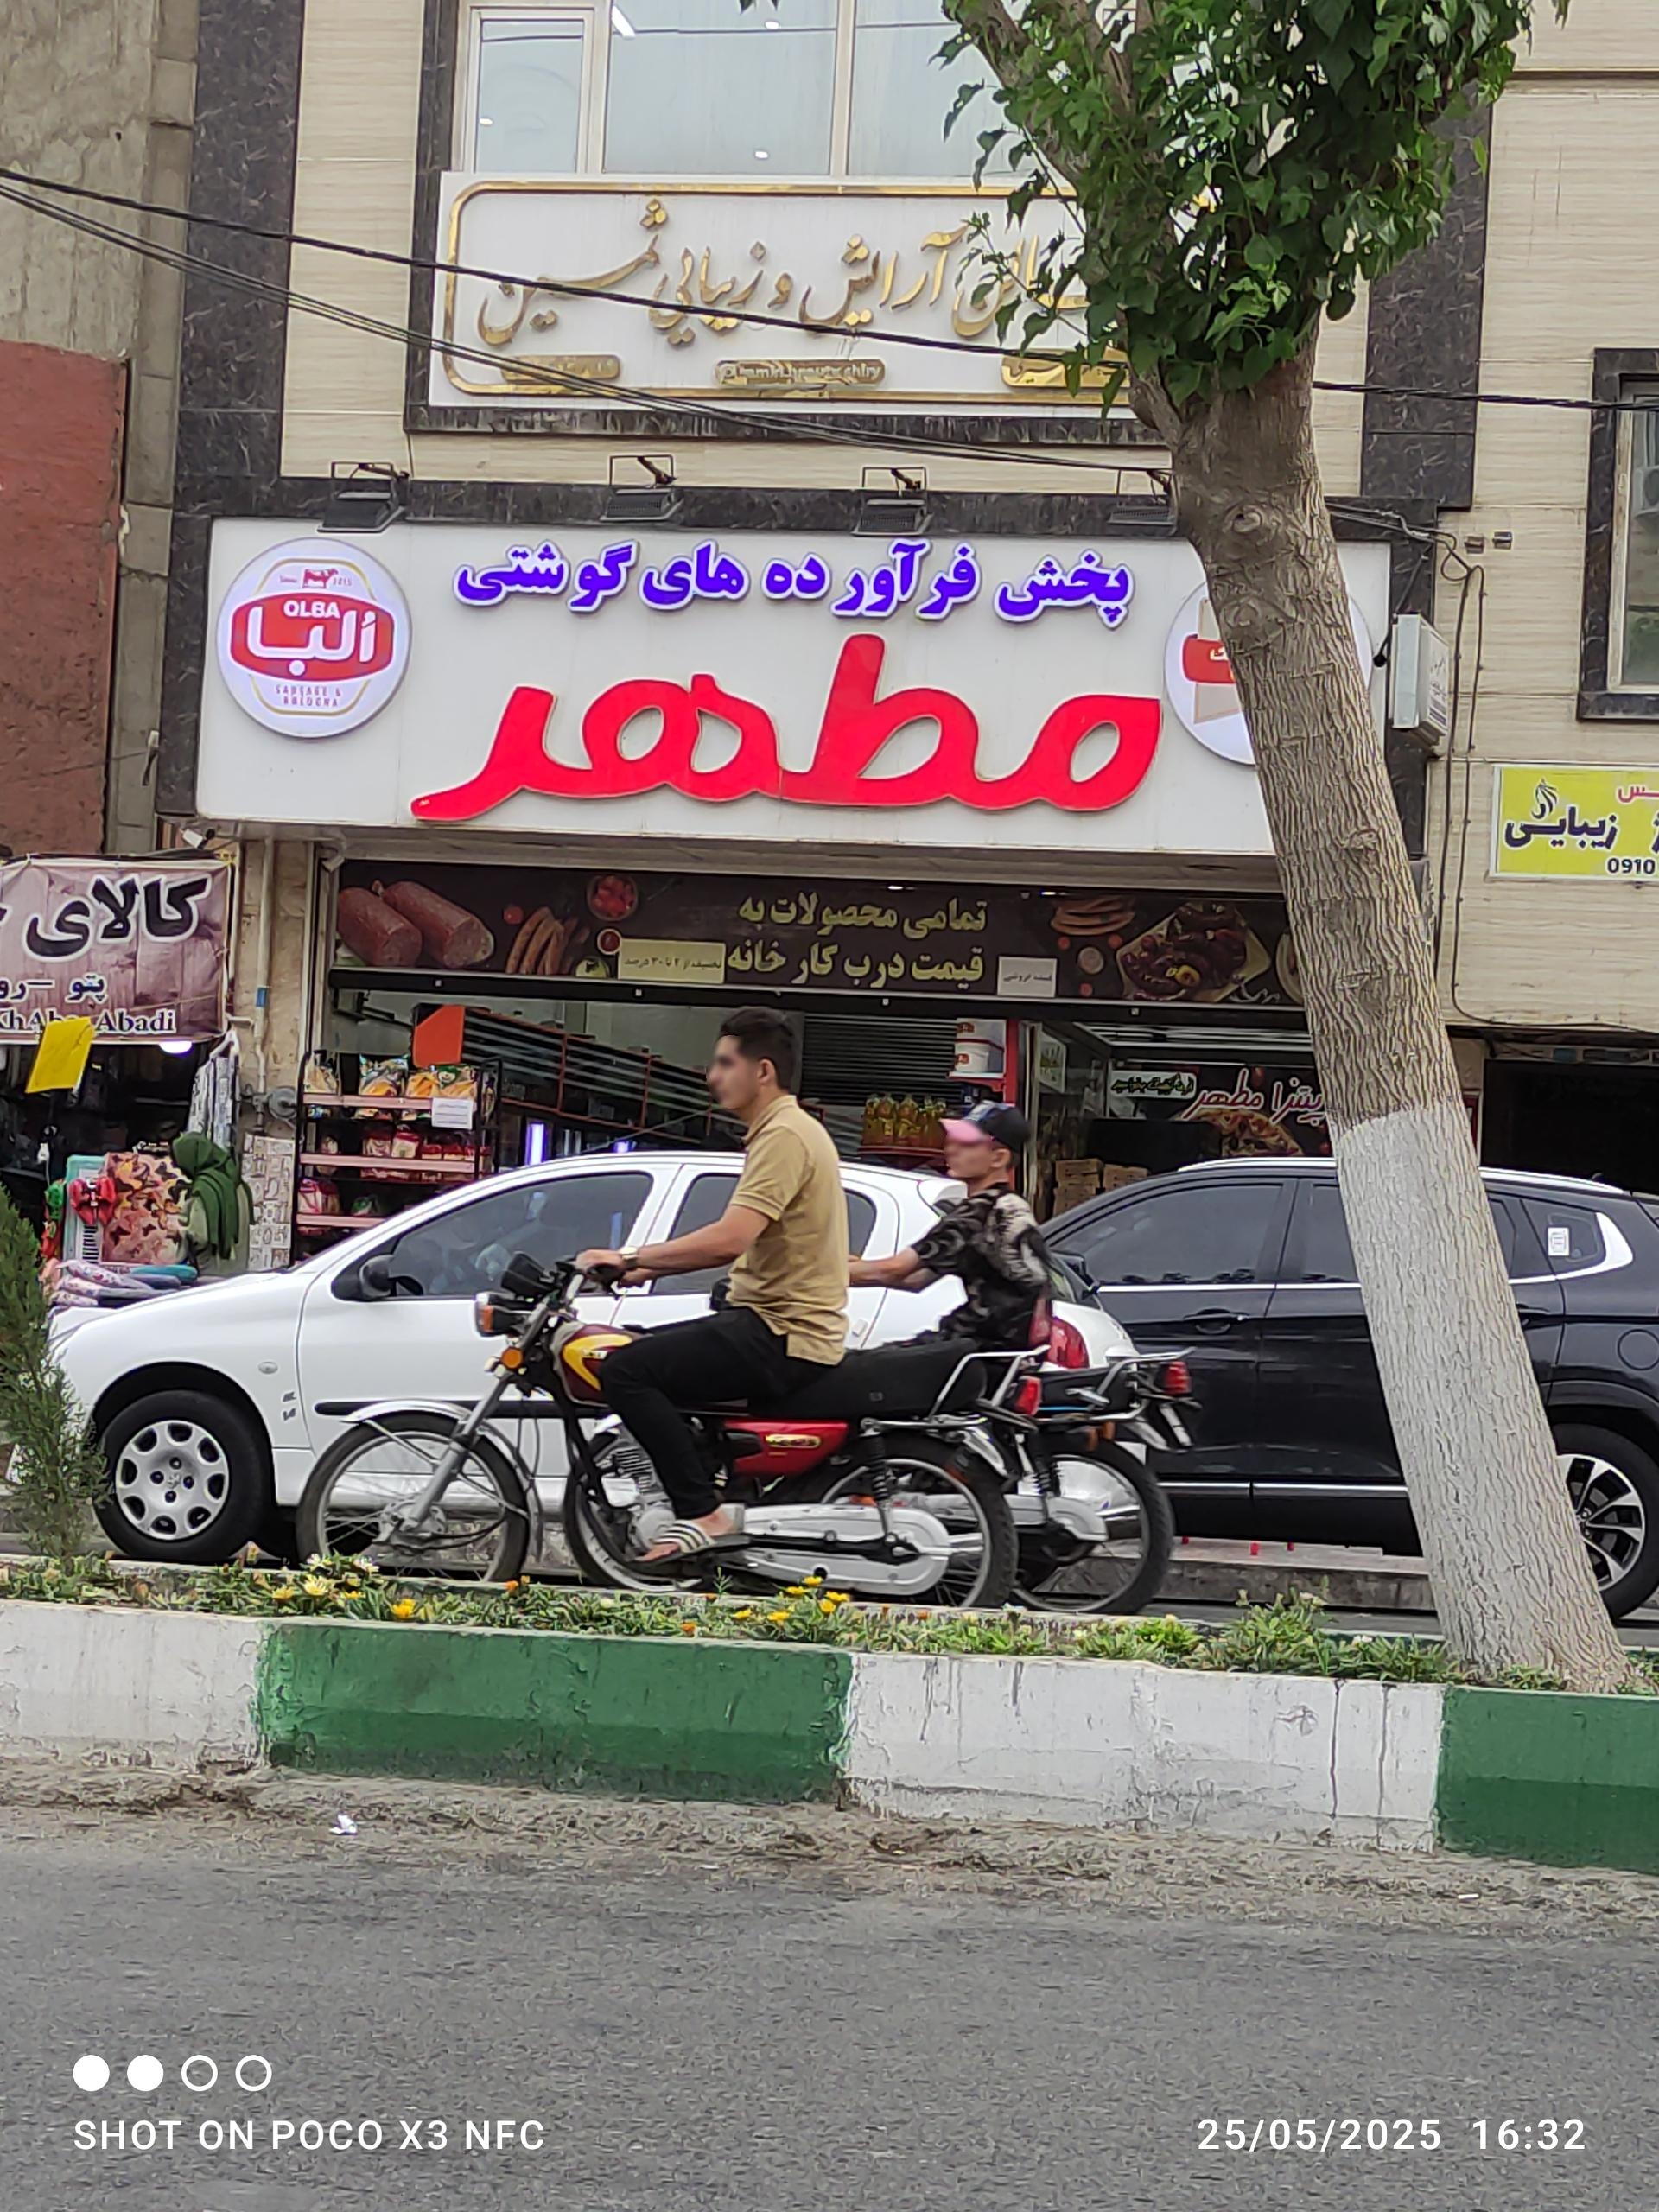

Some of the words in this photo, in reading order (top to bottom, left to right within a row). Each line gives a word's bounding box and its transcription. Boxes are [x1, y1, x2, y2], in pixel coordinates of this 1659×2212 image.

[649, 240, 764, 346] زیبایی
[766, 271, 794, 308] و
[799, 222, 969, 331] آرایش
[456, 543, 634, 608] گوشتی
[642, 543, 746, 607] های
[998, 550, 1132, 624] پخش
[283, 600, 341, 620] OLBA
[410, 635, 1161, 821] مطهر
[1504, 806, 1618, 850] زیبایی
[25, 877, 211, 958] کالای
[738, 897, 766, 930] به
[771, 892, 896, 931] محصولات
[903, 899, 987, 939] تمامی
[66, 974, 105, 1002] پتو
[844, 954, 906, 988] درب
[911, 947, 984, 990] قیمت
[96, 1009, 175, 1032] Abadi
[1181, 1068, 1264, 1121] مطهر
